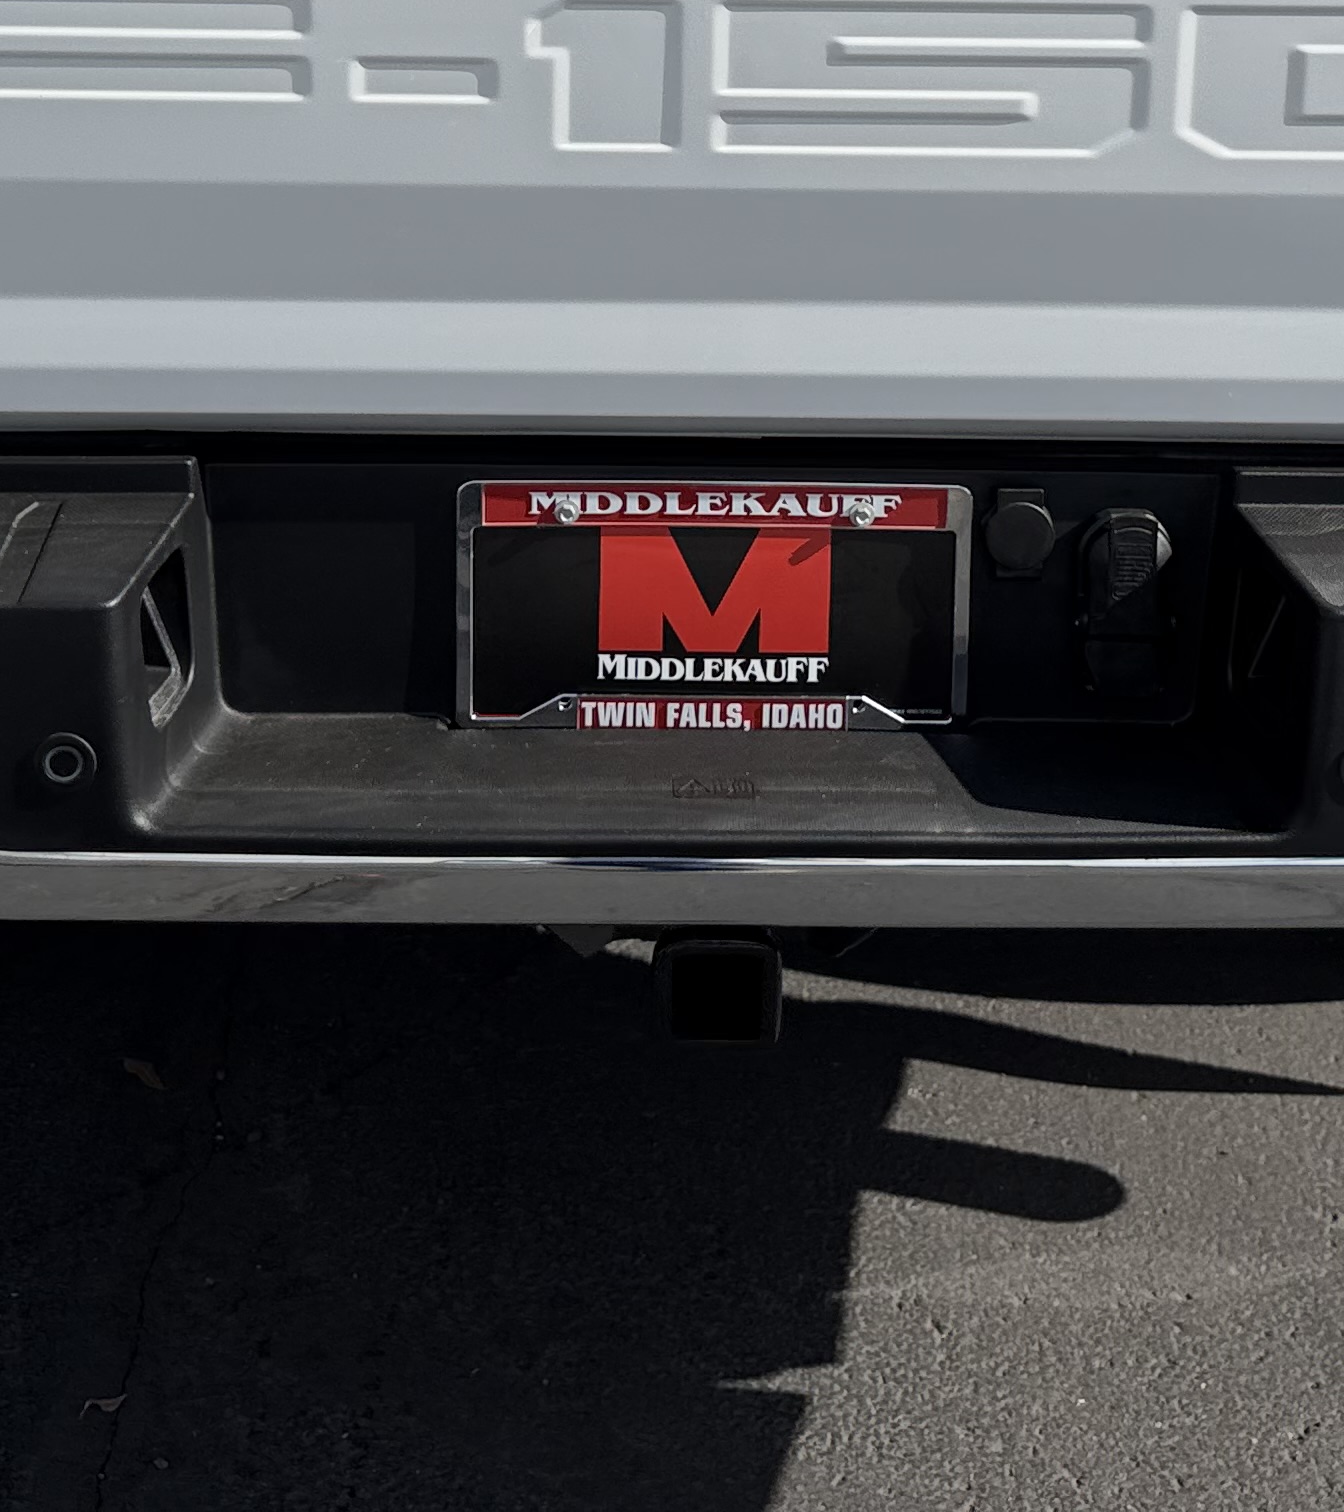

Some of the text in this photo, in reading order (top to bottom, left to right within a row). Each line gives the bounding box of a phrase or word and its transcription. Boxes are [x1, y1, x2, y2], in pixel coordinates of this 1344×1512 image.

[598, 526, 832, 653] M
[597, 654, 829, 683] MIDDLEKAUFF
[581, 701, 843, 731] TWIN FALLS, IDAHO
